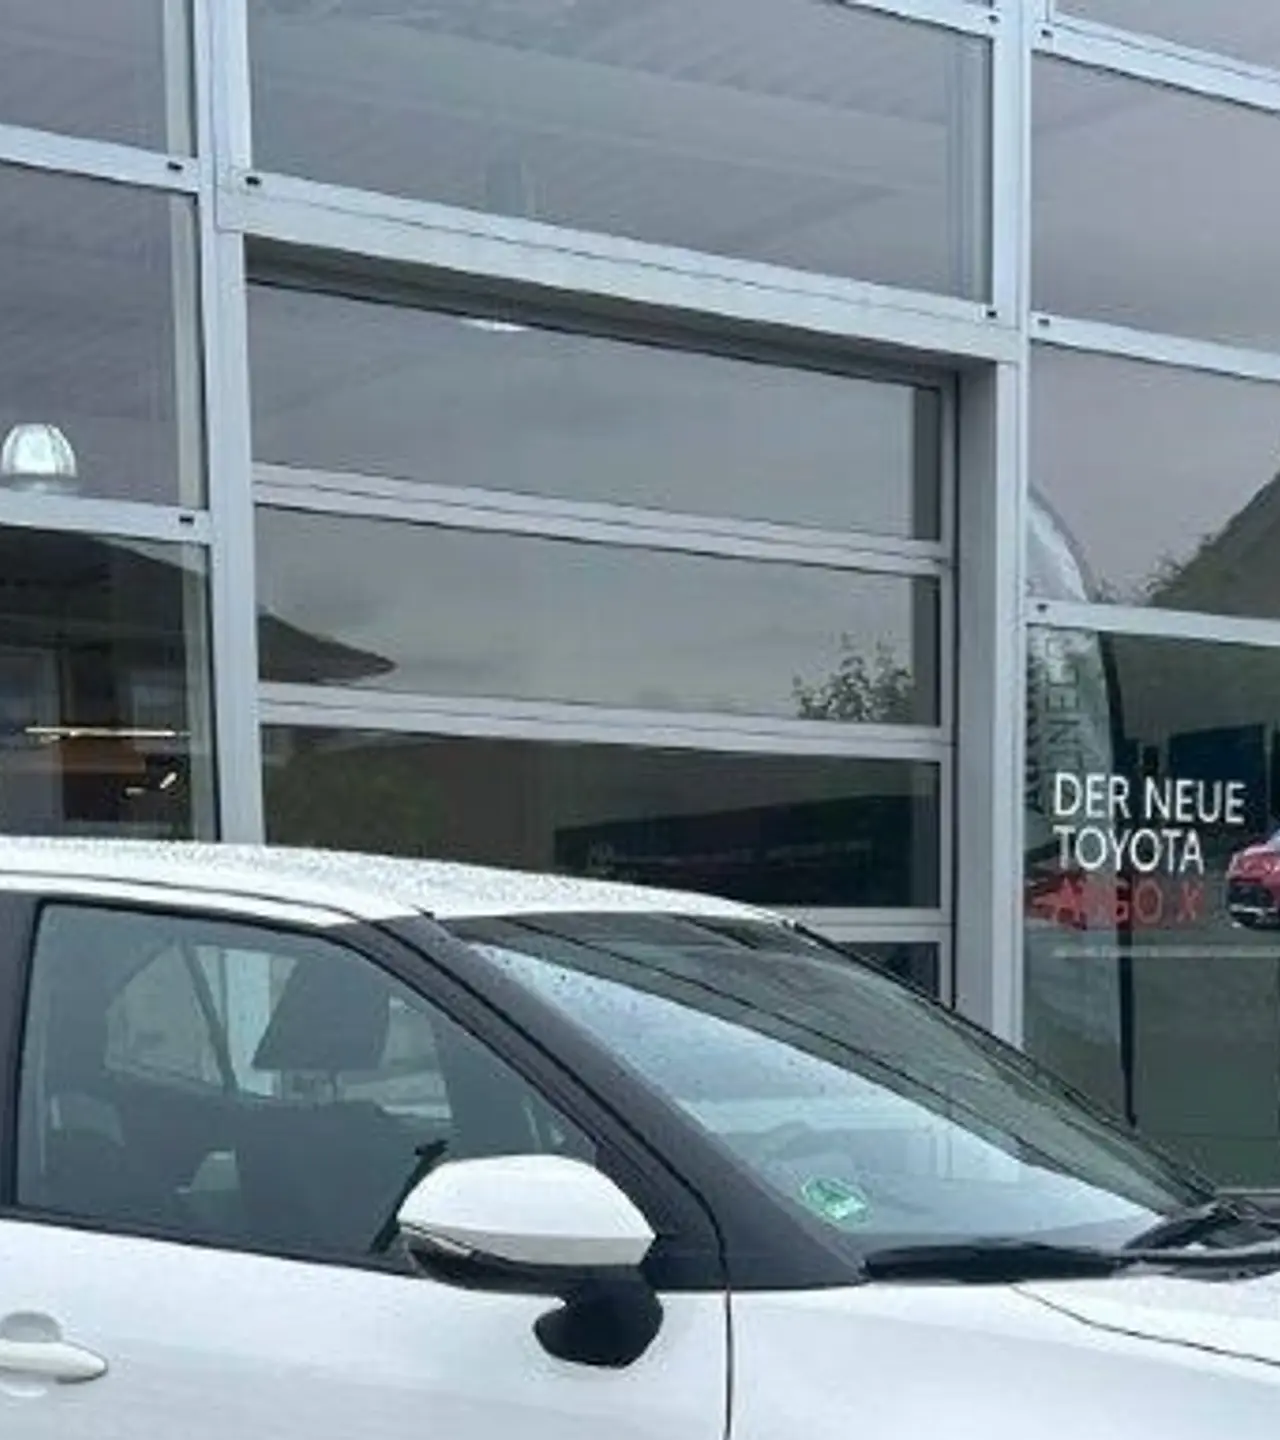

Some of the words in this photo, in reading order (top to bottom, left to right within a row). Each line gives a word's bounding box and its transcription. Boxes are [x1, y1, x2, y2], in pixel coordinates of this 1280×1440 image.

[1053, 771, 1131, 820] DER
[1145, 778, 1247, 825] NEUE
[1052, 824, 1205, 875] TOYOTA
